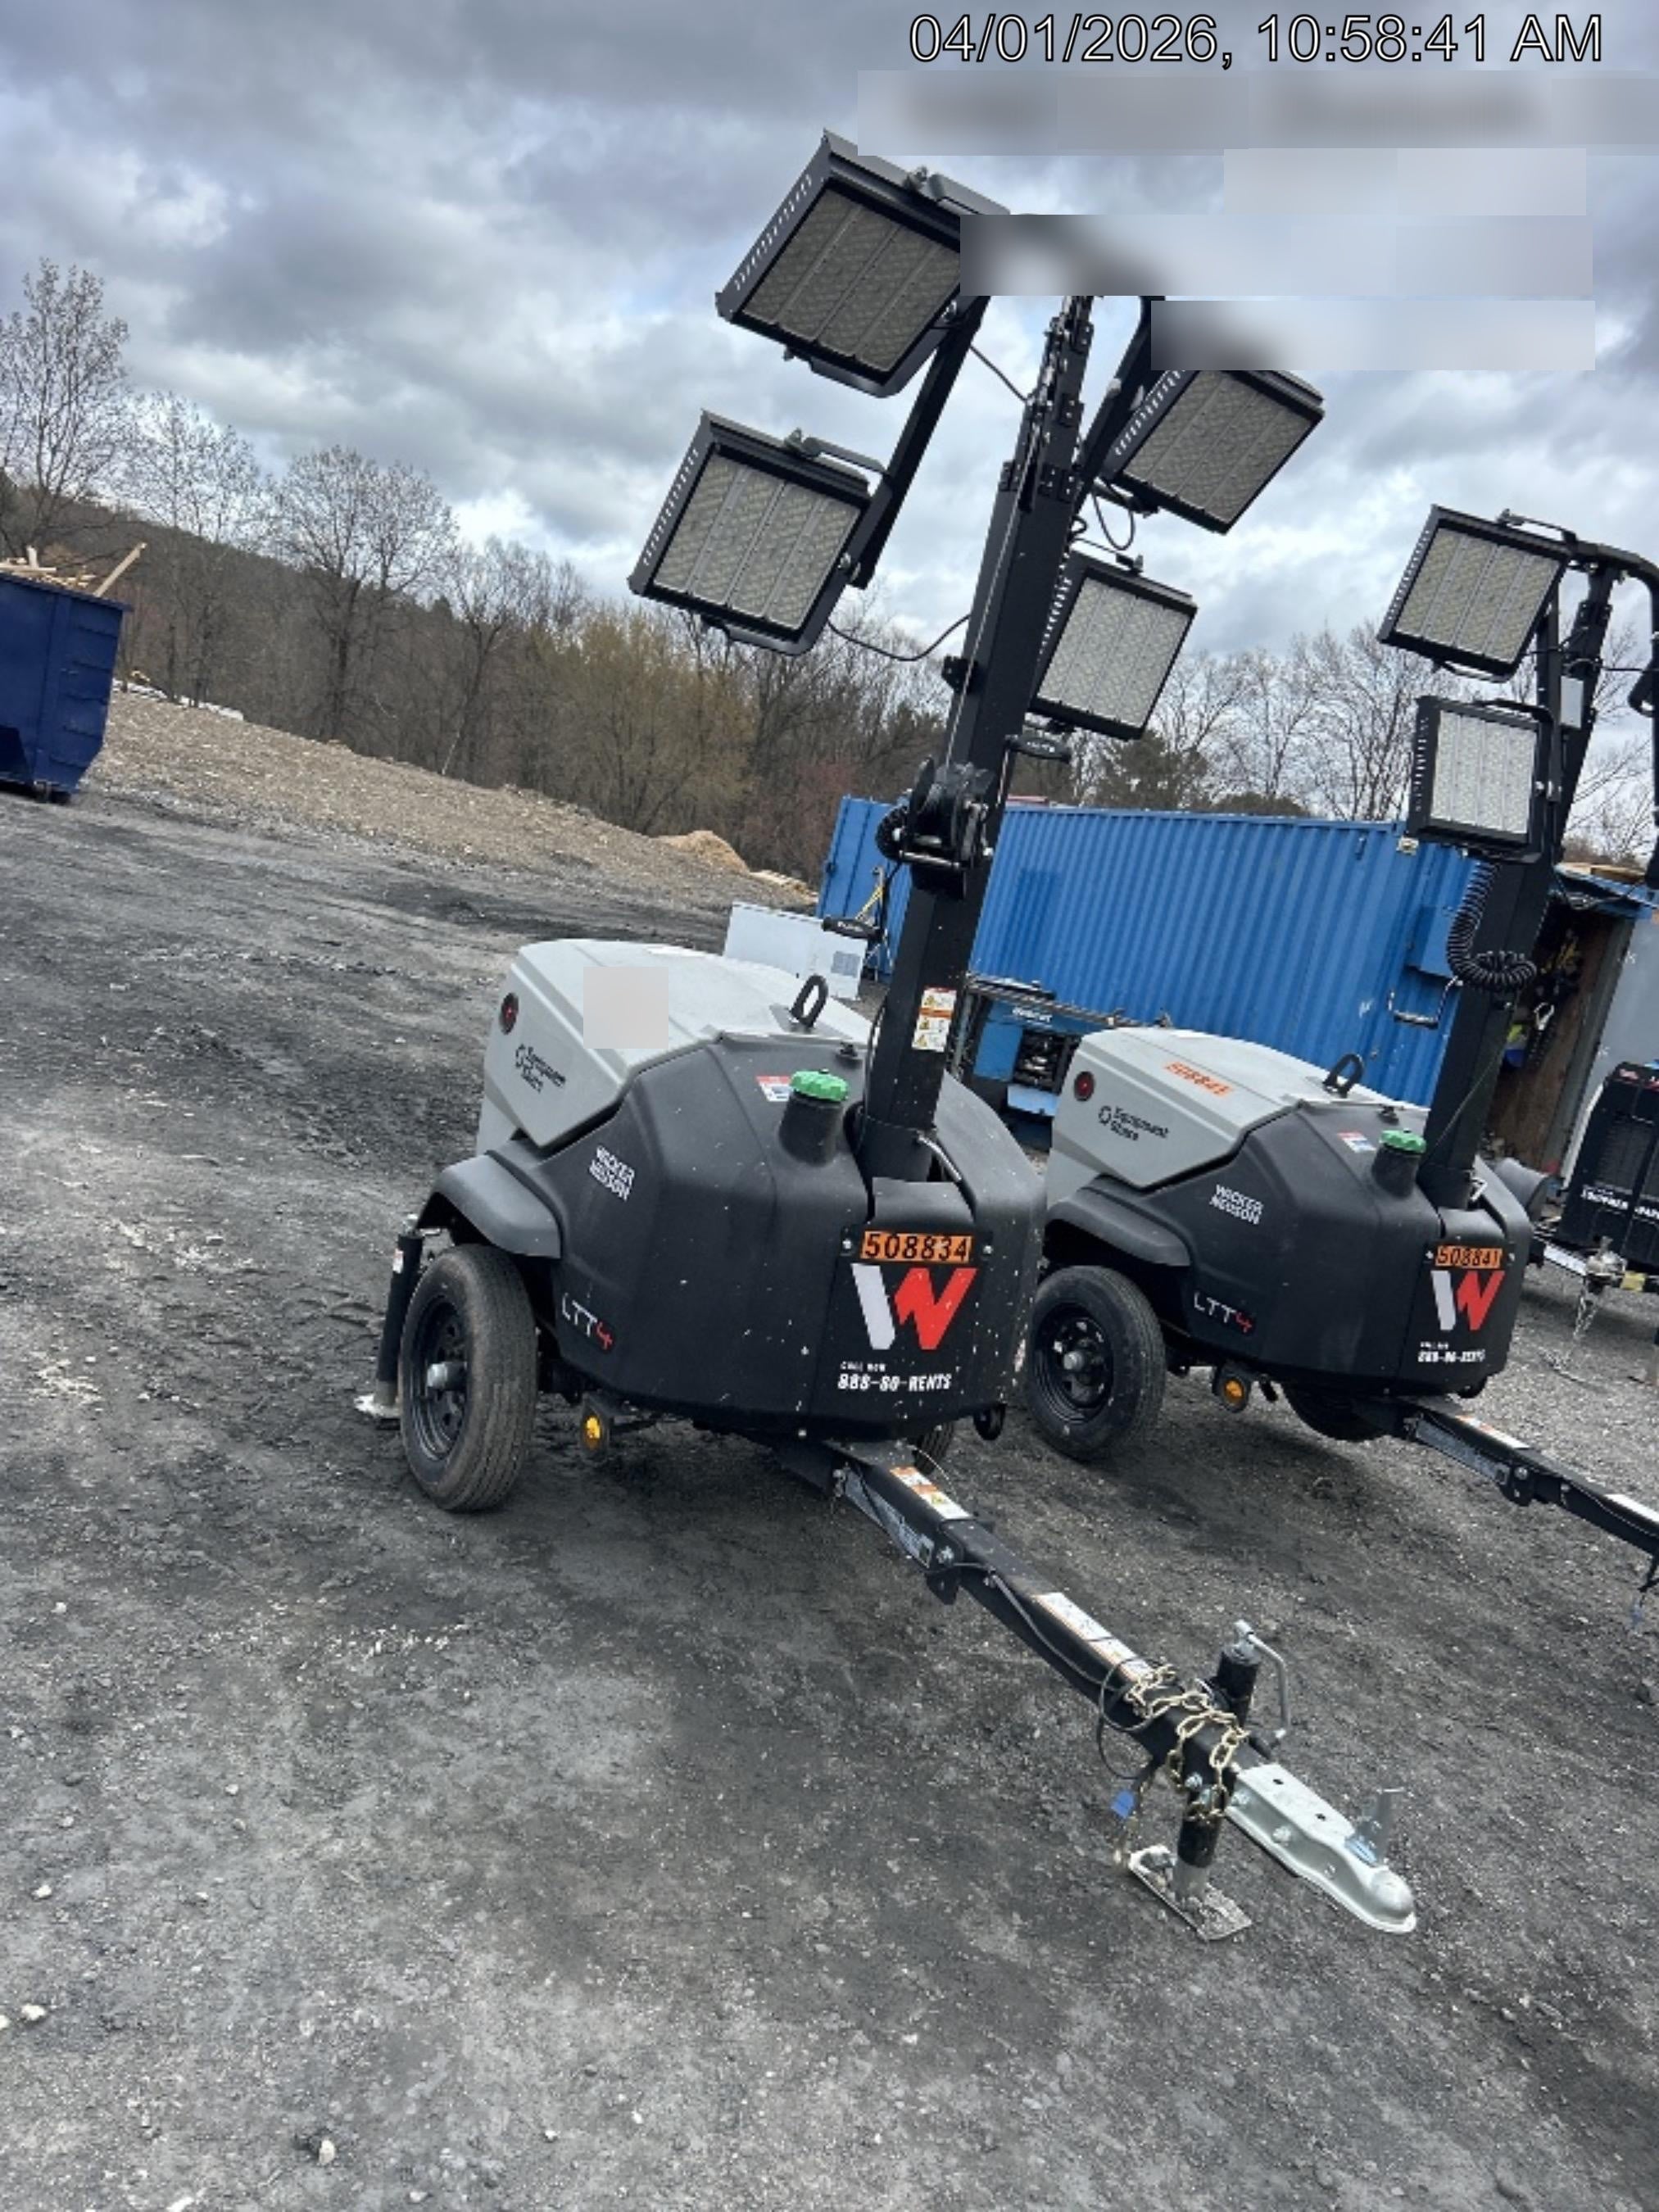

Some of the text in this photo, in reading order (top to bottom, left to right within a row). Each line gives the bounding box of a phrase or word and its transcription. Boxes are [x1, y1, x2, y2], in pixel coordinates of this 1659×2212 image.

[864, 1234, 968, 1261] 508834
[1436, 1246, 1500, 1267] 508841
[562, 1292, 613, 1351] LTT4
[1194, 1290, 1253, 1333] LTT4
